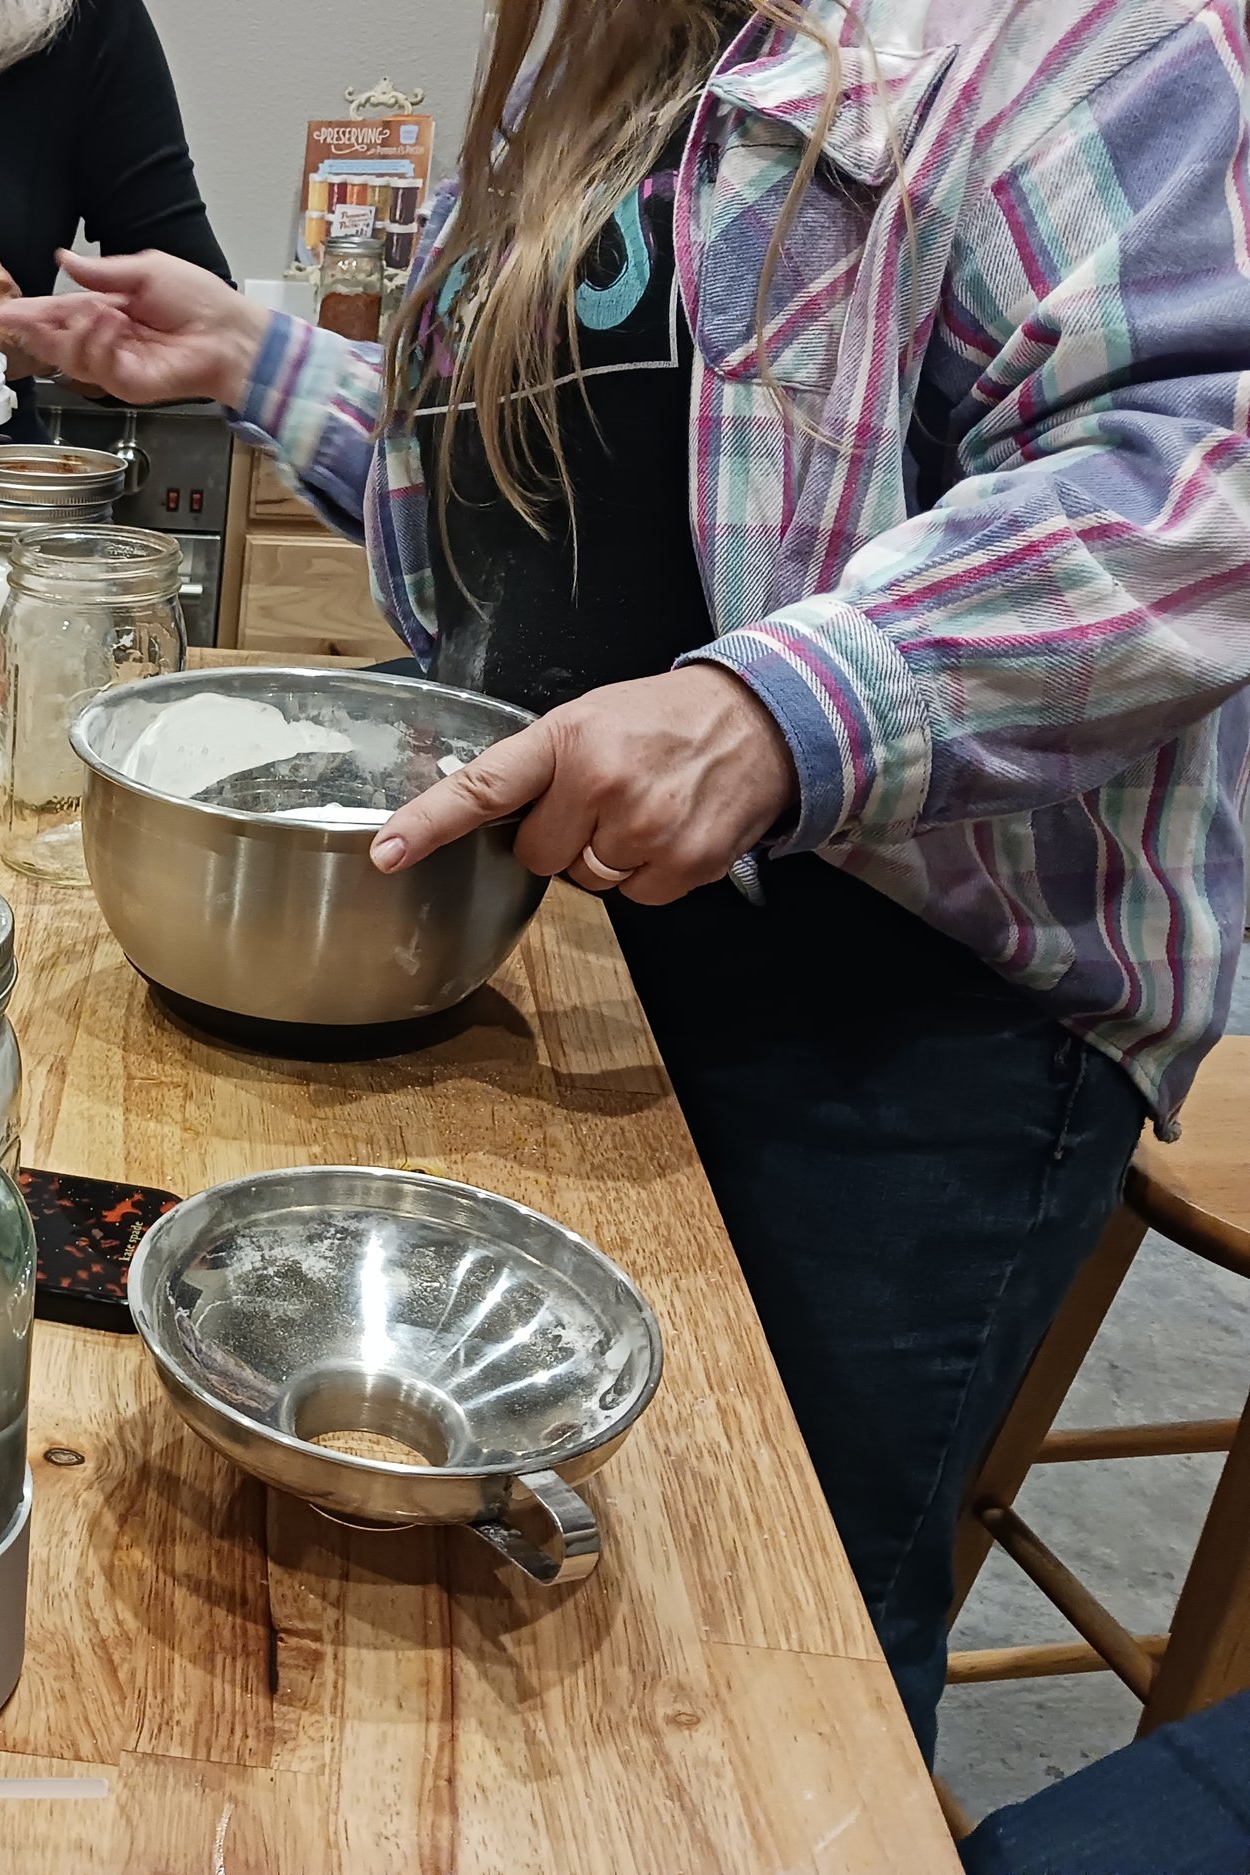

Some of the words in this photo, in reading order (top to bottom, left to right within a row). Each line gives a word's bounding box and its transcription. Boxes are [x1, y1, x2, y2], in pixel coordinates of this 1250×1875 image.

[314, 127, 390, 145] PRESERVING
[118, 1243, 136, 1262] kate
[128, 1220, 144, 1244] spade
